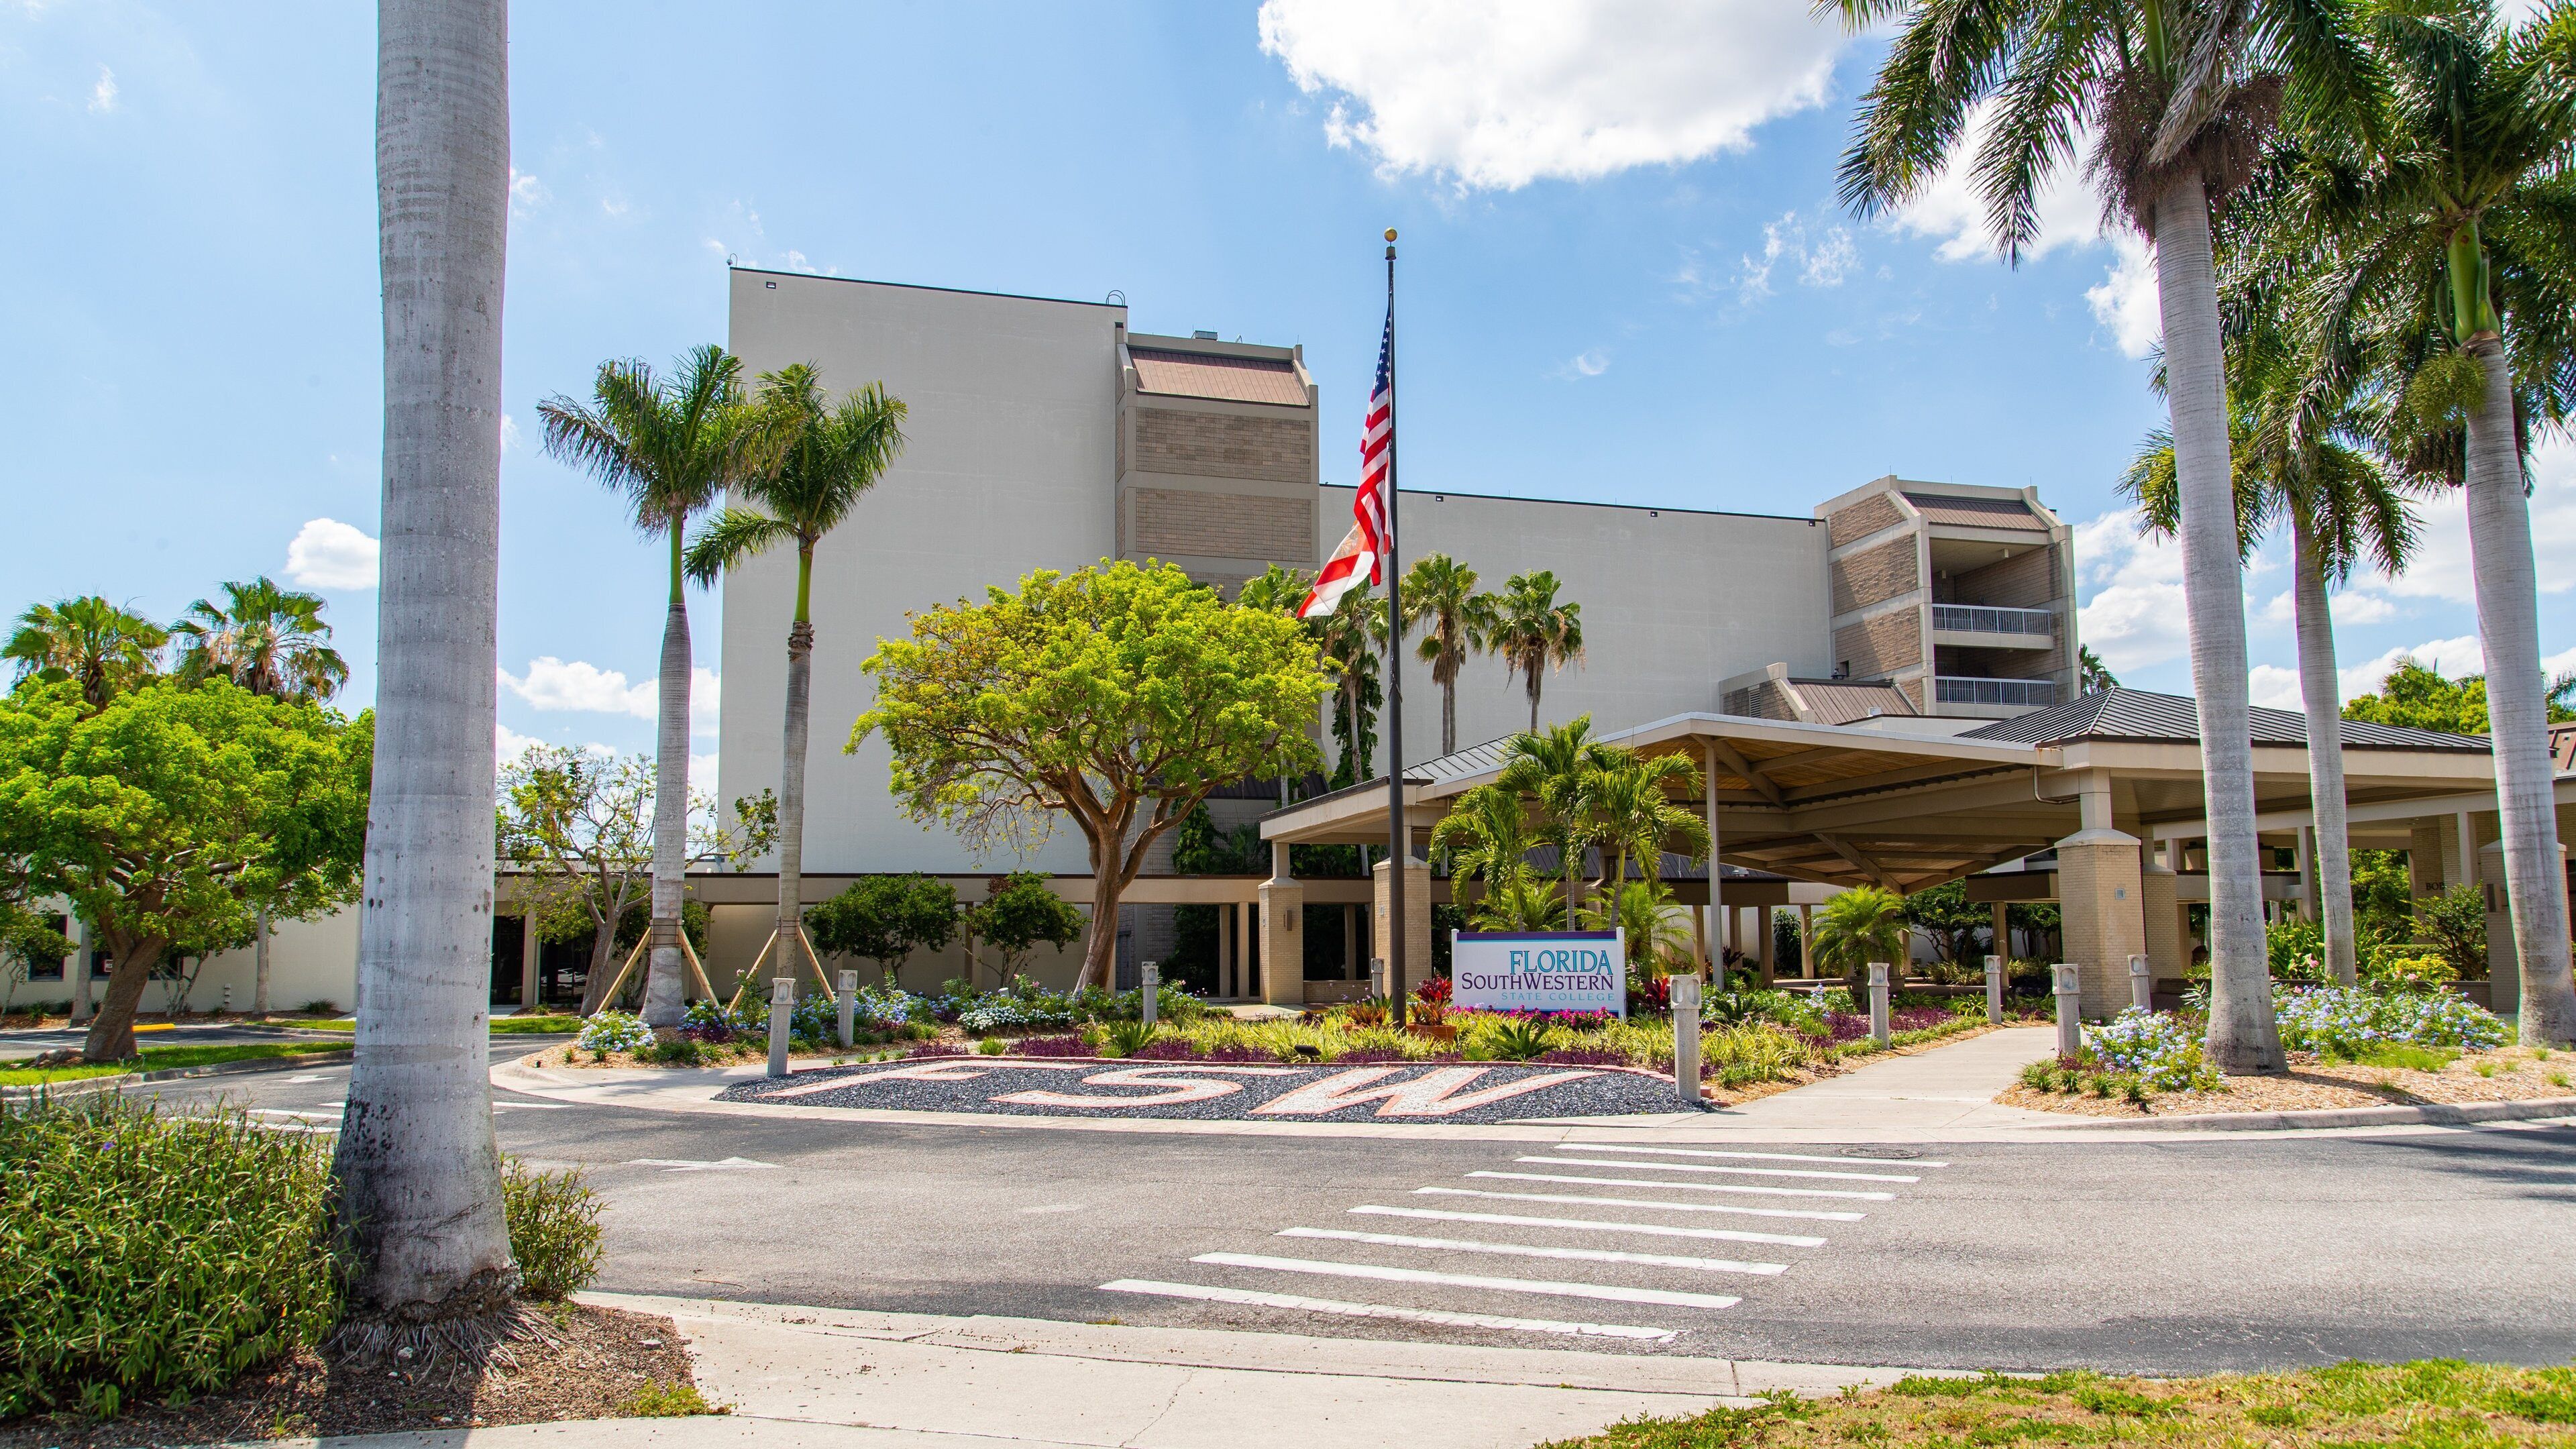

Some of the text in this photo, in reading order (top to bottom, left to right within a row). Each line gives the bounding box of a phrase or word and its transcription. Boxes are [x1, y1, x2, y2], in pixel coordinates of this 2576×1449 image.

[1509, 950, 1613, 975] FLORIDA
[1501, 992, 1615, 1001] STATE COLLEGE
[757, 1059, 1610, 1116] FSW
